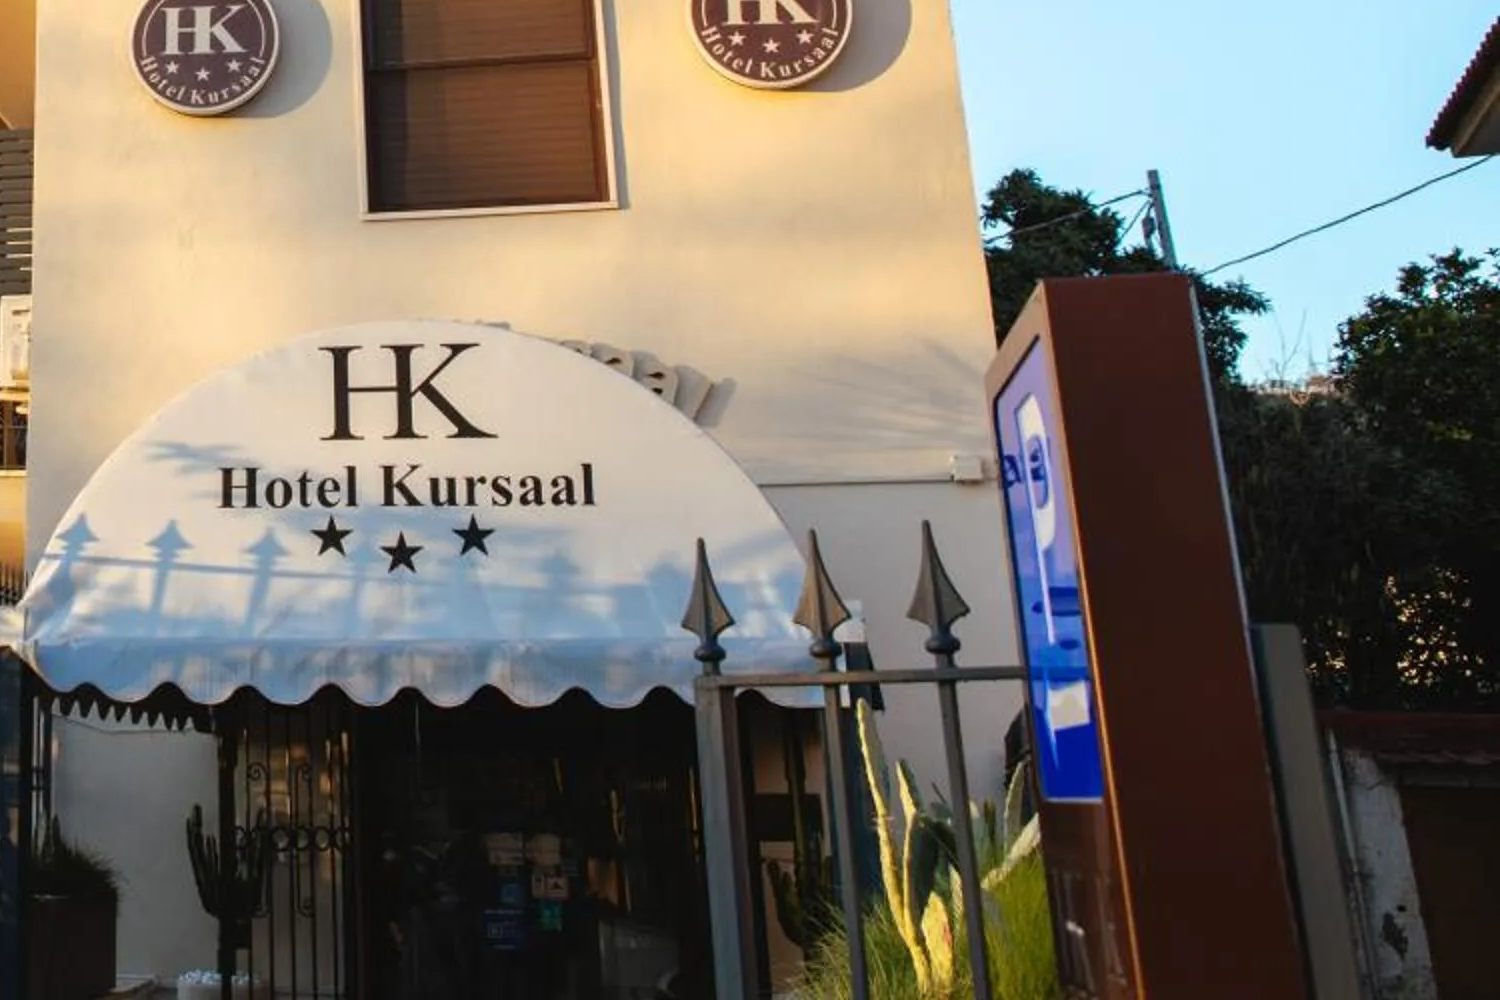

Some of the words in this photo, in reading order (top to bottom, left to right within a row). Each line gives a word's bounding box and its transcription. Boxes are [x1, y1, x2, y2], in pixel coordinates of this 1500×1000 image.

[160, 3, 248, 55] HK
[701, 26, 753, 74] Hotel
[759, 27, 840, 80] Kursaal
[140, 56, 186, 101] Hotel
[190, 56, 266, 105] Kursaal
[318, 343, 500, 441] HK
[218, 465, 359, 509] Hotel
[378, 463, 597, 508] Kursaal
